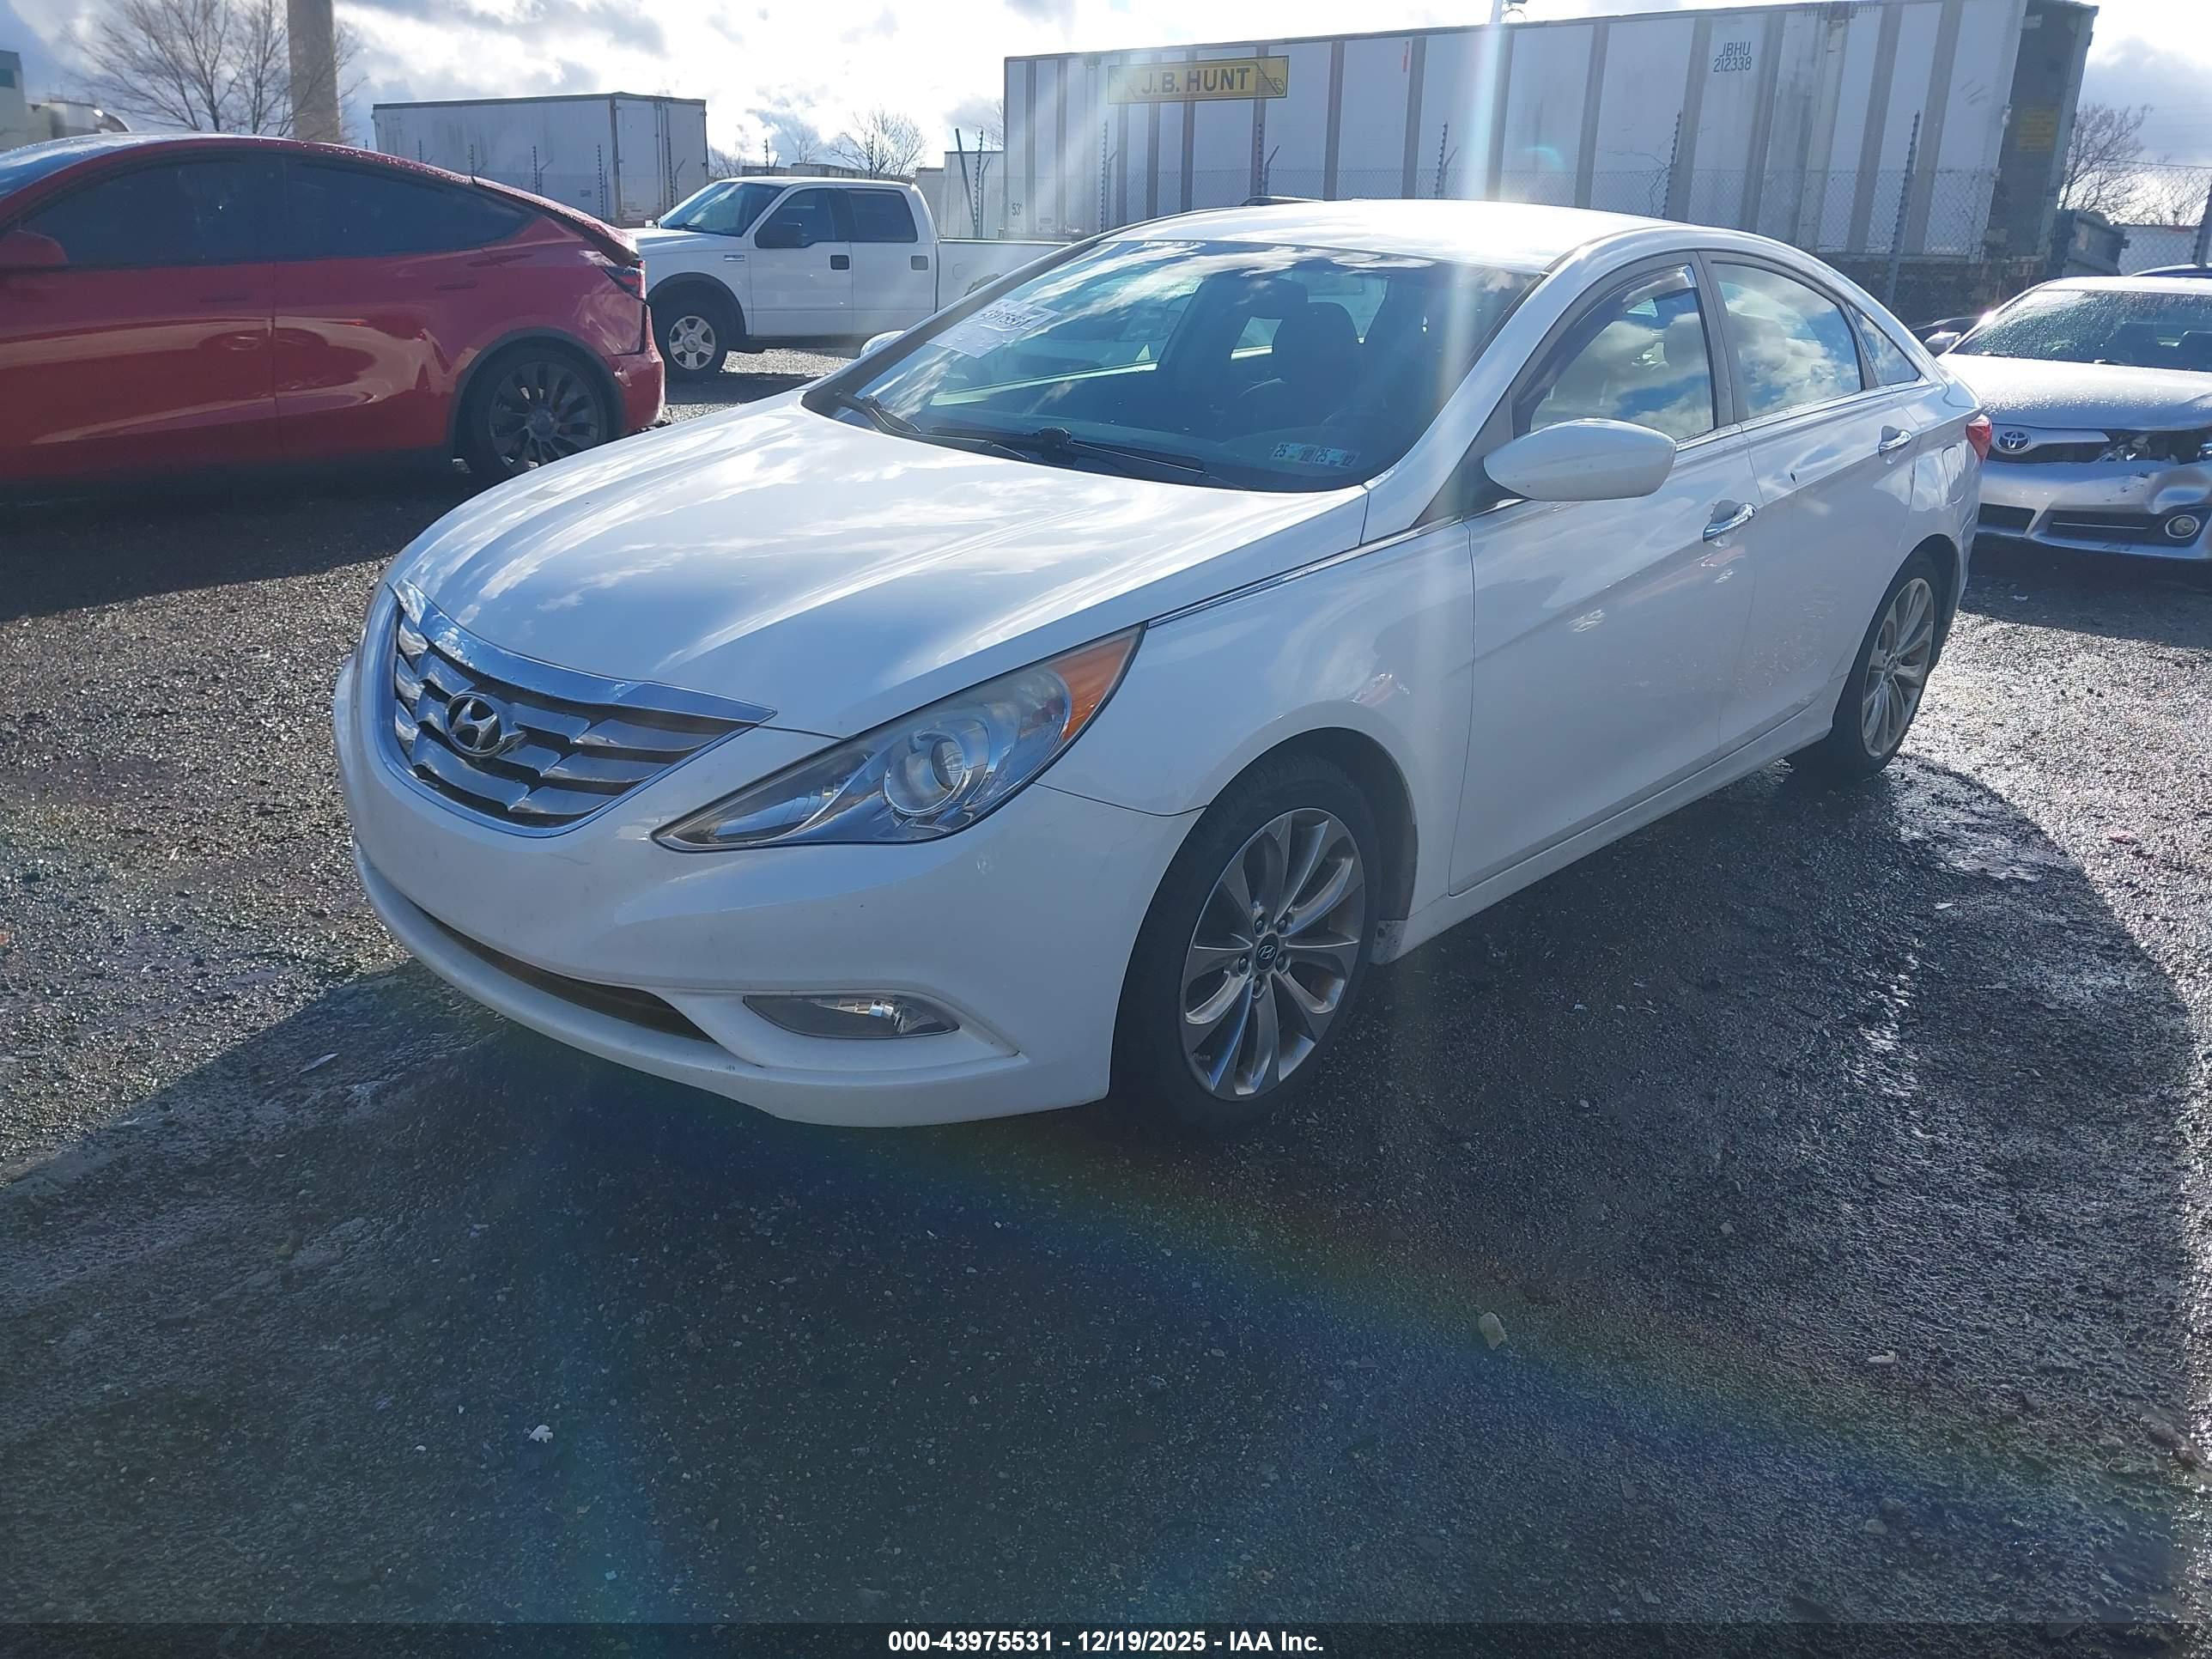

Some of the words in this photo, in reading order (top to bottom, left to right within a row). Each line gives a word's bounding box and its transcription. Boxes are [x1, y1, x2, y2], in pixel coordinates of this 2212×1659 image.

[1719, 41, 1751, 58] JBHU
[1713, 56, 1753, 73] 212338
[1140, 71, 1181, 94] J.B.
[1187, 67, 1251, 92] HUNT
